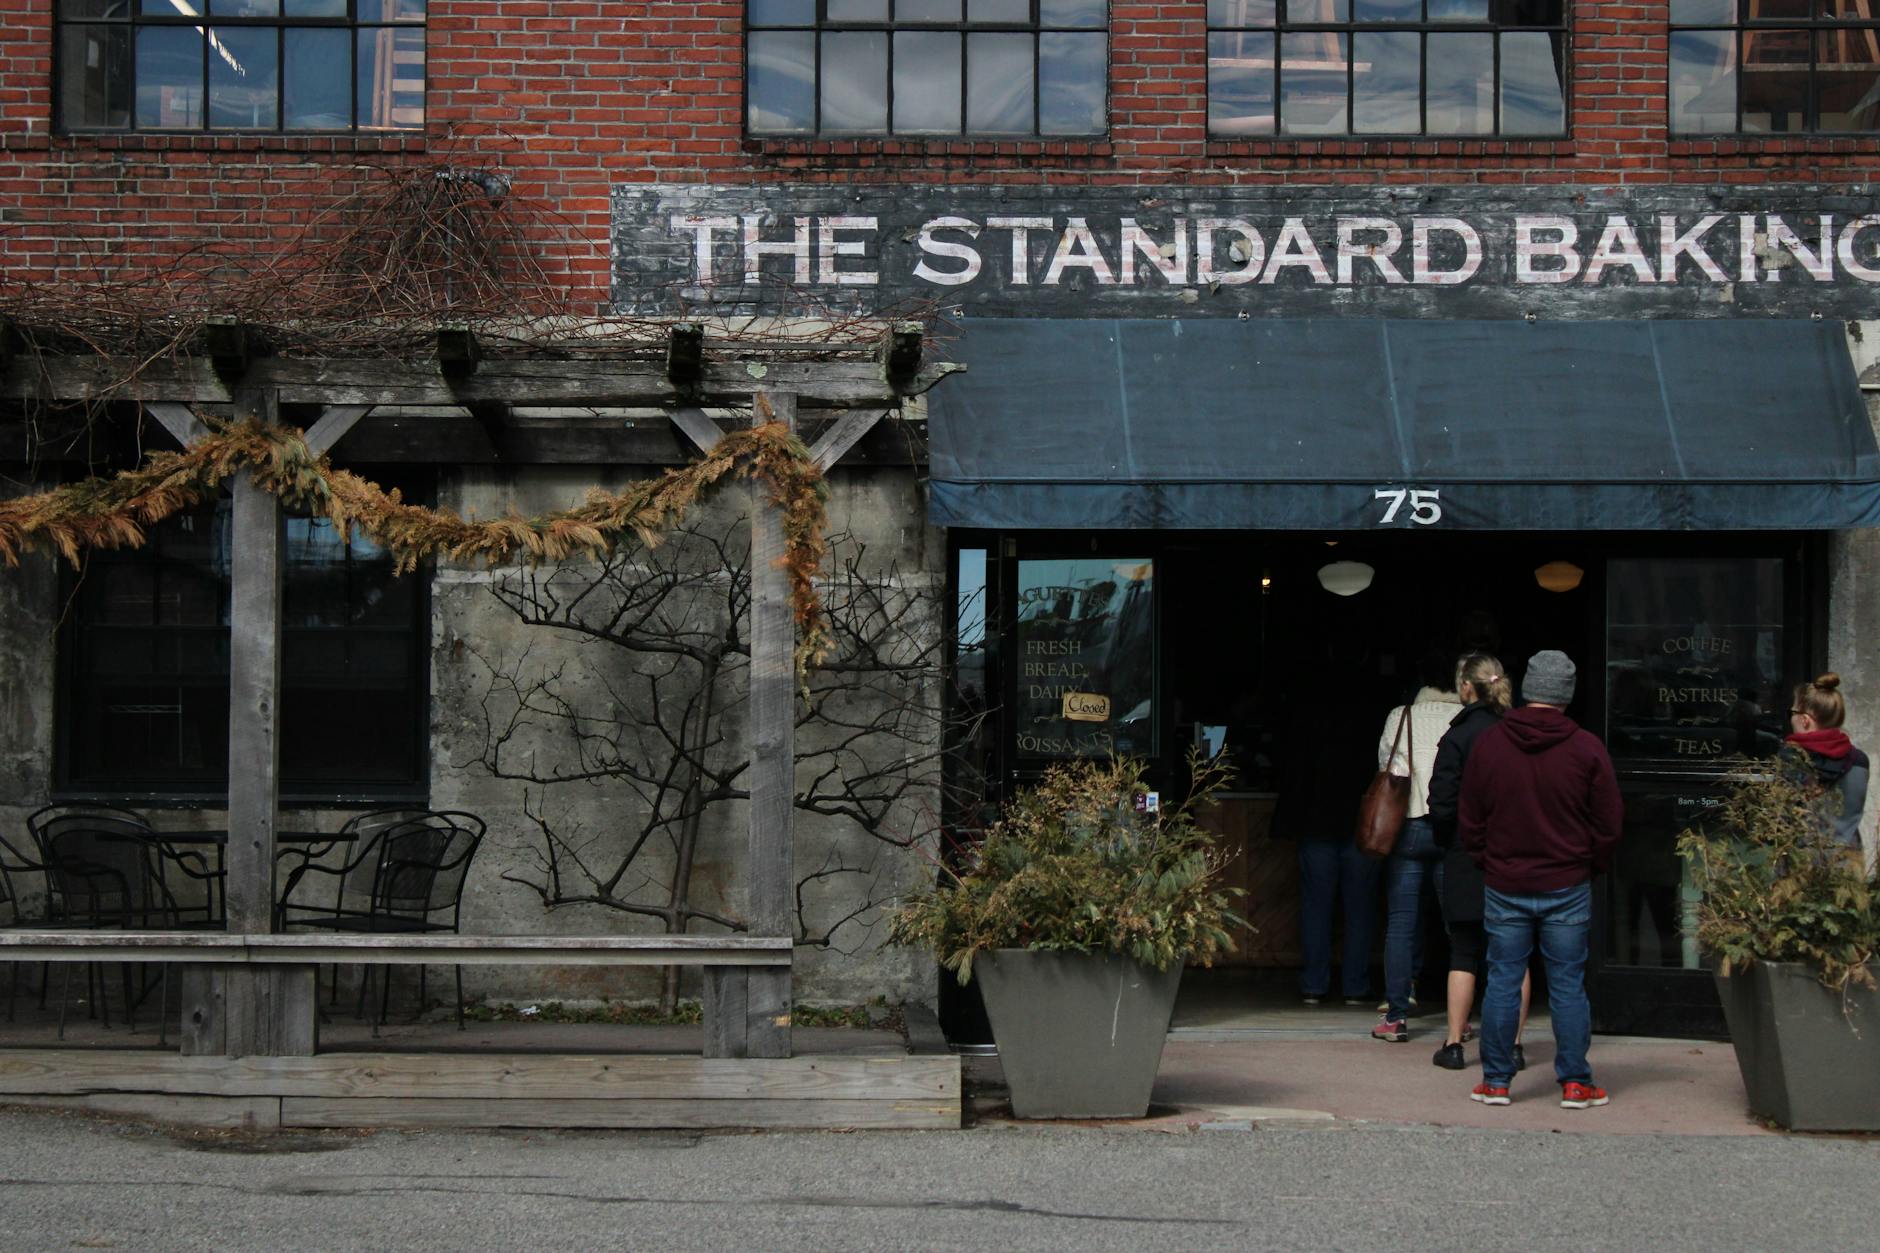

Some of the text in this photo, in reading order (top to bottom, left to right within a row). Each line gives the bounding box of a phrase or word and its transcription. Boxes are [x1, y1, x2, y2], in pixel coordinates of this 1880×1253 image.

[670, 213, 880, 286] THE
[911, 214, 1485, 286] STANDARD
[1374, 488, 1442, 525] 75
[1026, 640, 1081, 655] FRESH
[1025, 662, 1084, 678] BREAD
[1658, 688, 1738, 703] PASTRIES
[1068, 696, 1106, 713] Closed
[1674, 738, 1722, 754] TEAS
[1678, 797, 1695, 805] 8am
[1700, 797, 1719, 807] 5pm
